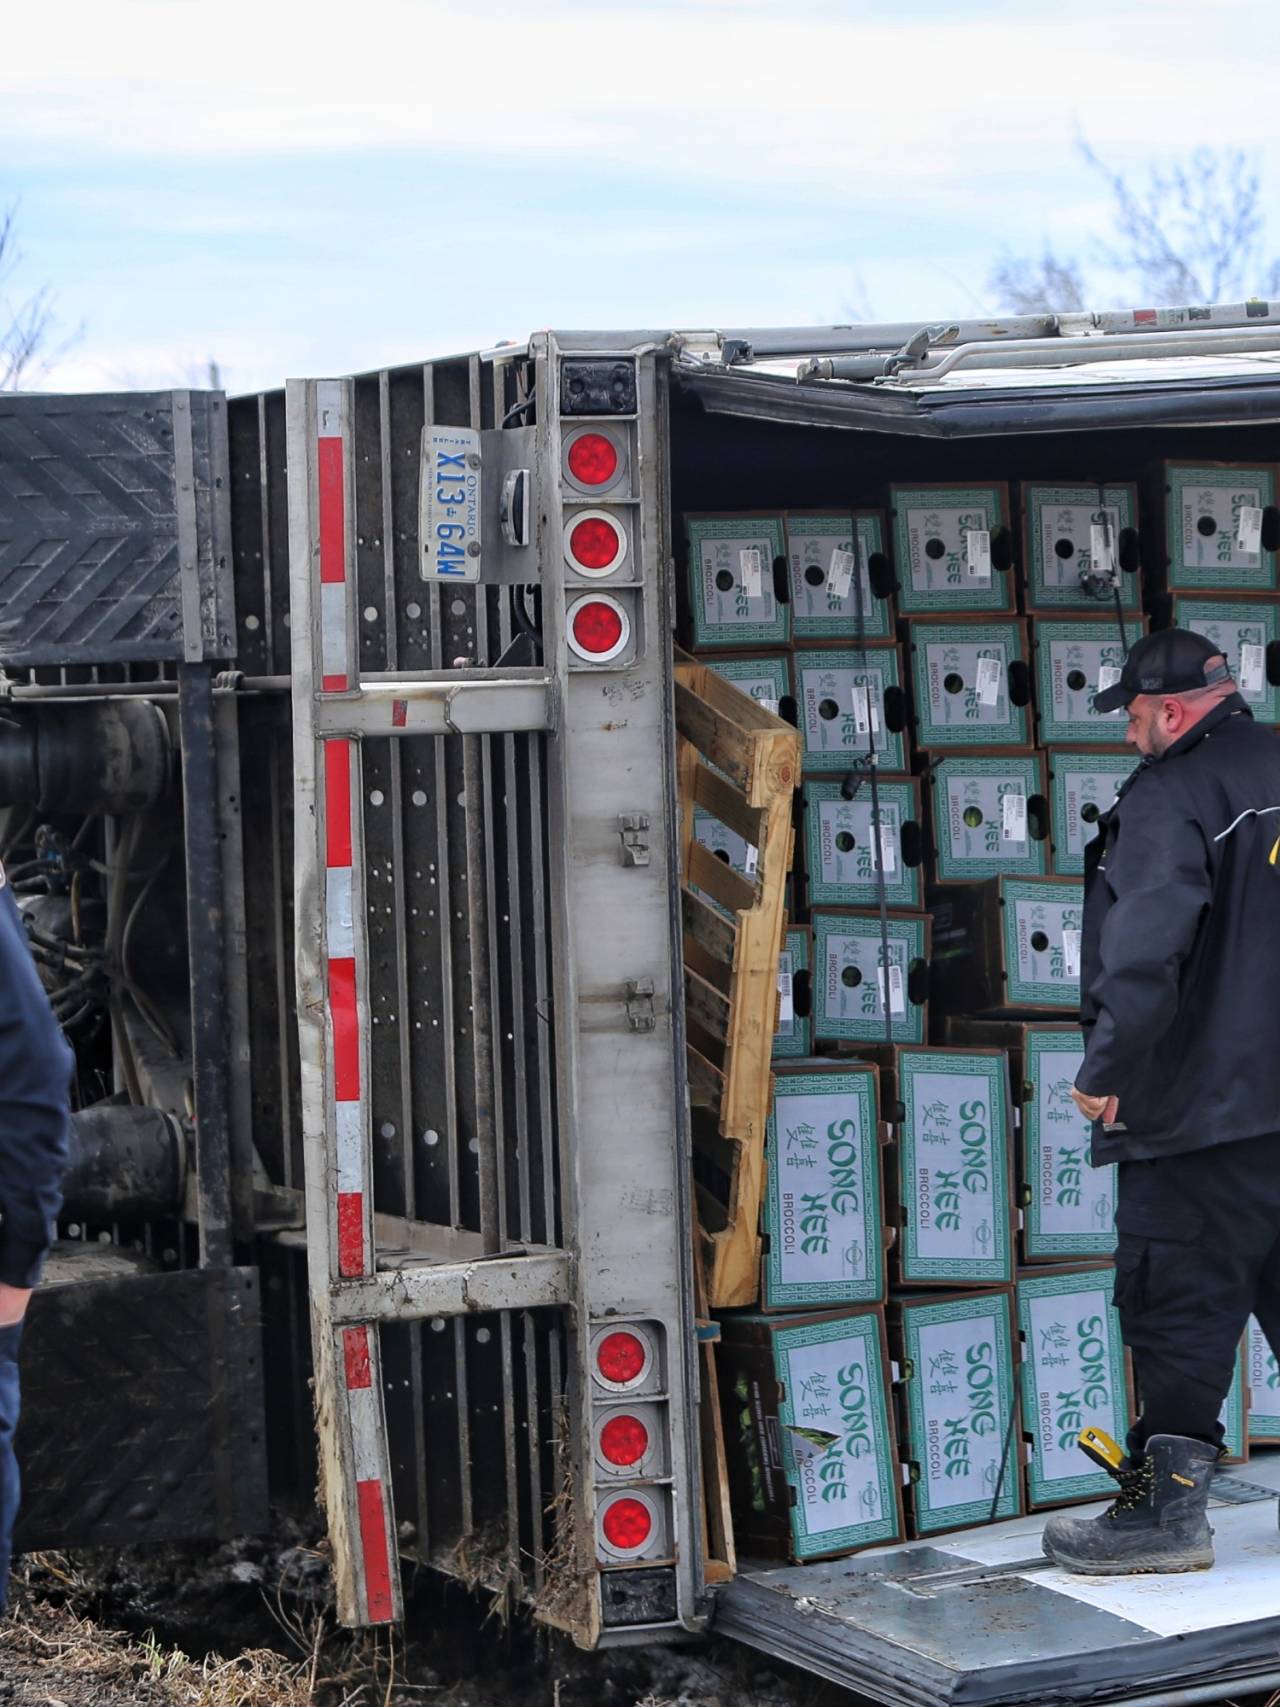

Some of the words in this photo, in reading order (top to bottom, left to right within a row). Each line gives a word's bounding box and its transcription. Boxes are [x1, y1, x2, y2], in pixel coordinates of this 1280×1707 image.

[437, 452, 466, 505] X13
[467, 475, 477, 536] ONTARIO
[437, 523, 466, 576] 64W
[828, 953, 838, 1000] BROCCOLI
[827, 1118, 860, 1217] SONG
[960, 1100, 988, 1196] SONG
[1043, 1145, 1053, 1207] BROCCOLI
[1057, 1146, 1081, 1209] HEE
[783, 1192, 796, 1256] BROCCOLI
[800, 1192, 829, 1258] HEE
[919, 1168, 930, 1230] BROCCOLI
[934, 1169, 961, 1233] HEE
[966, 1341, 997, 1438] SONG
[1077, 1315, 1109, 1411] SONG
[837, 1362, 872, 1460] SONG
[1039, 1391, 1052, 1453] BROCCOLI
[1055, 1390, 1084, 1452] HEE
[819, 1443, 848, 1504] HEE
[928, 1419, 940, 1481] BROCCOLI
[943, 1417, 971, 1481] HEE
